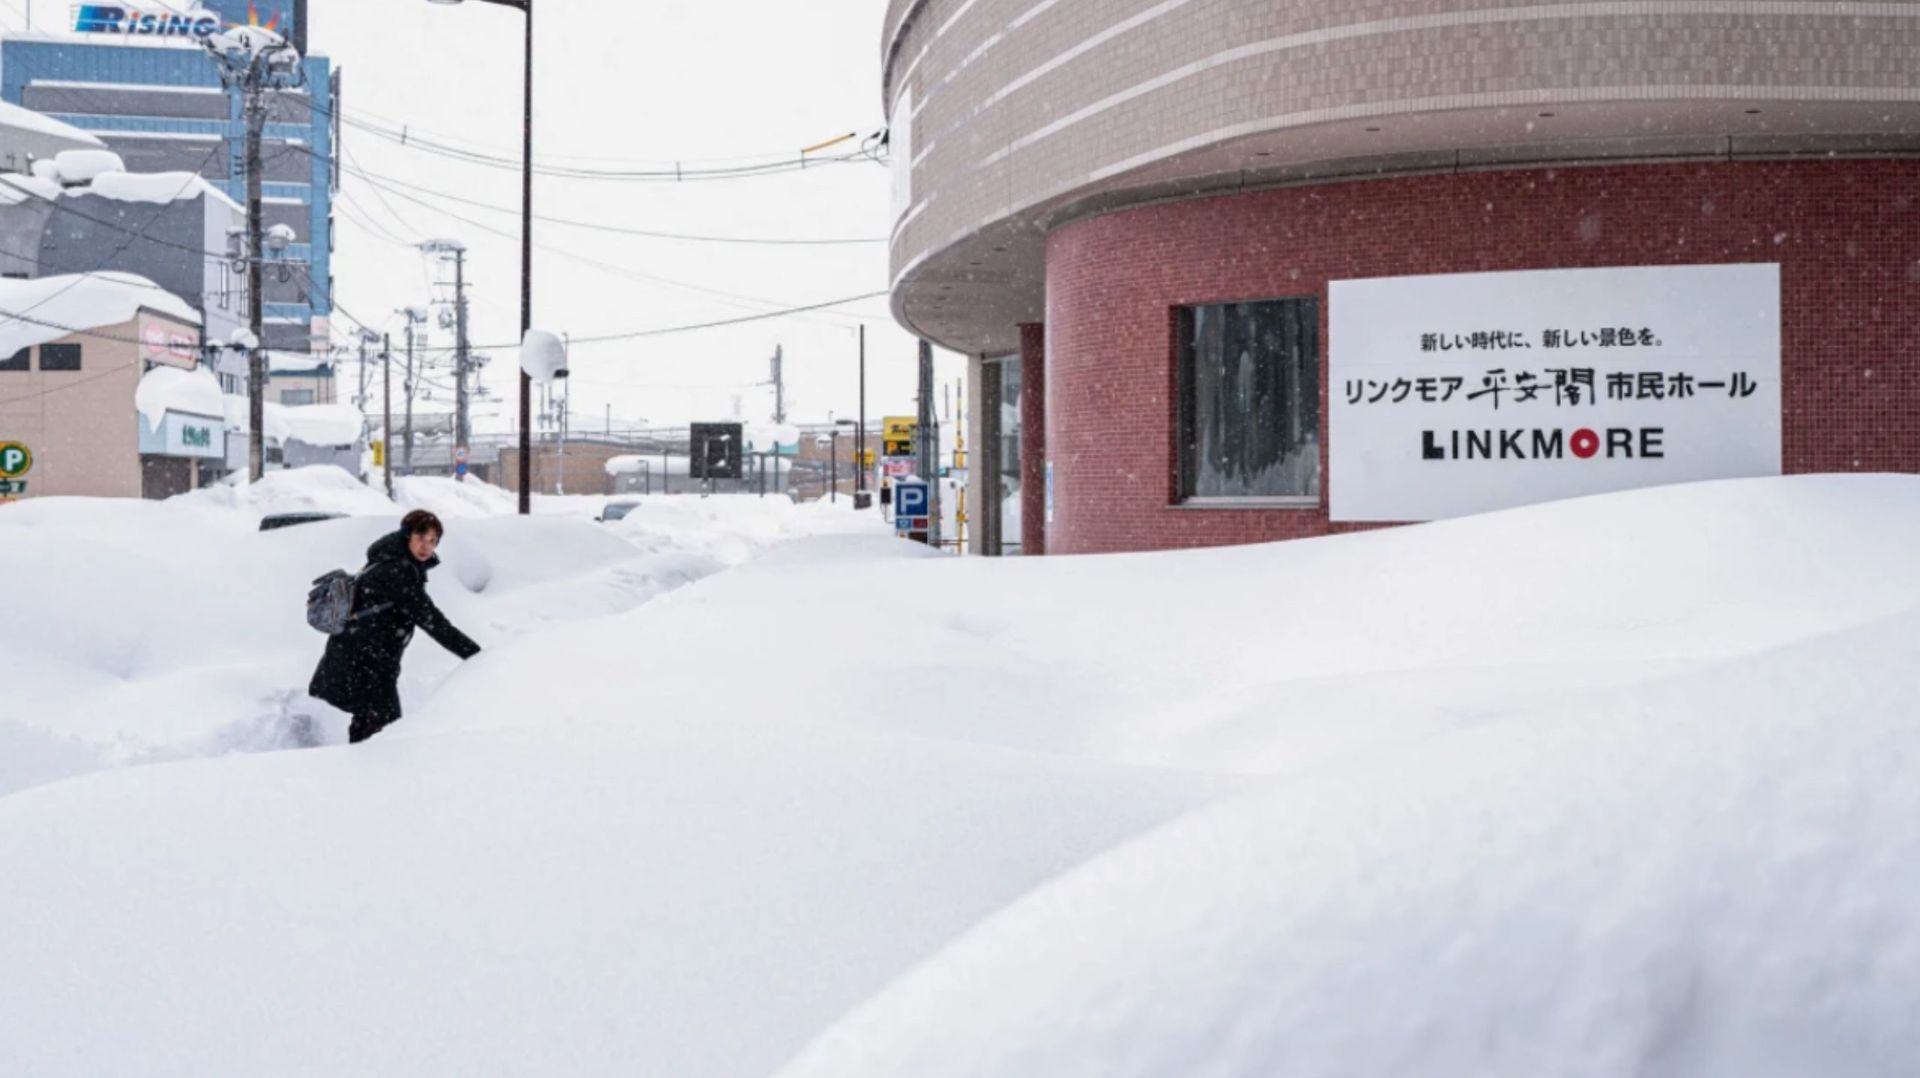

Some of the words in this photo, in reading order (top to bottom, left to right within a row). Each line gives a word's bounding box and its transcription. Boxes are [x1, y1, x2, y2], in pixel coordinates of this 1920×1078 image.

[1421, 327, 1662, 351] 新しい時代に、新しい景色を。
[1422, 427, 1664, 460] LINKMORE
[6, 449, 23, 471] P
[900, 488, 923, 513] P
